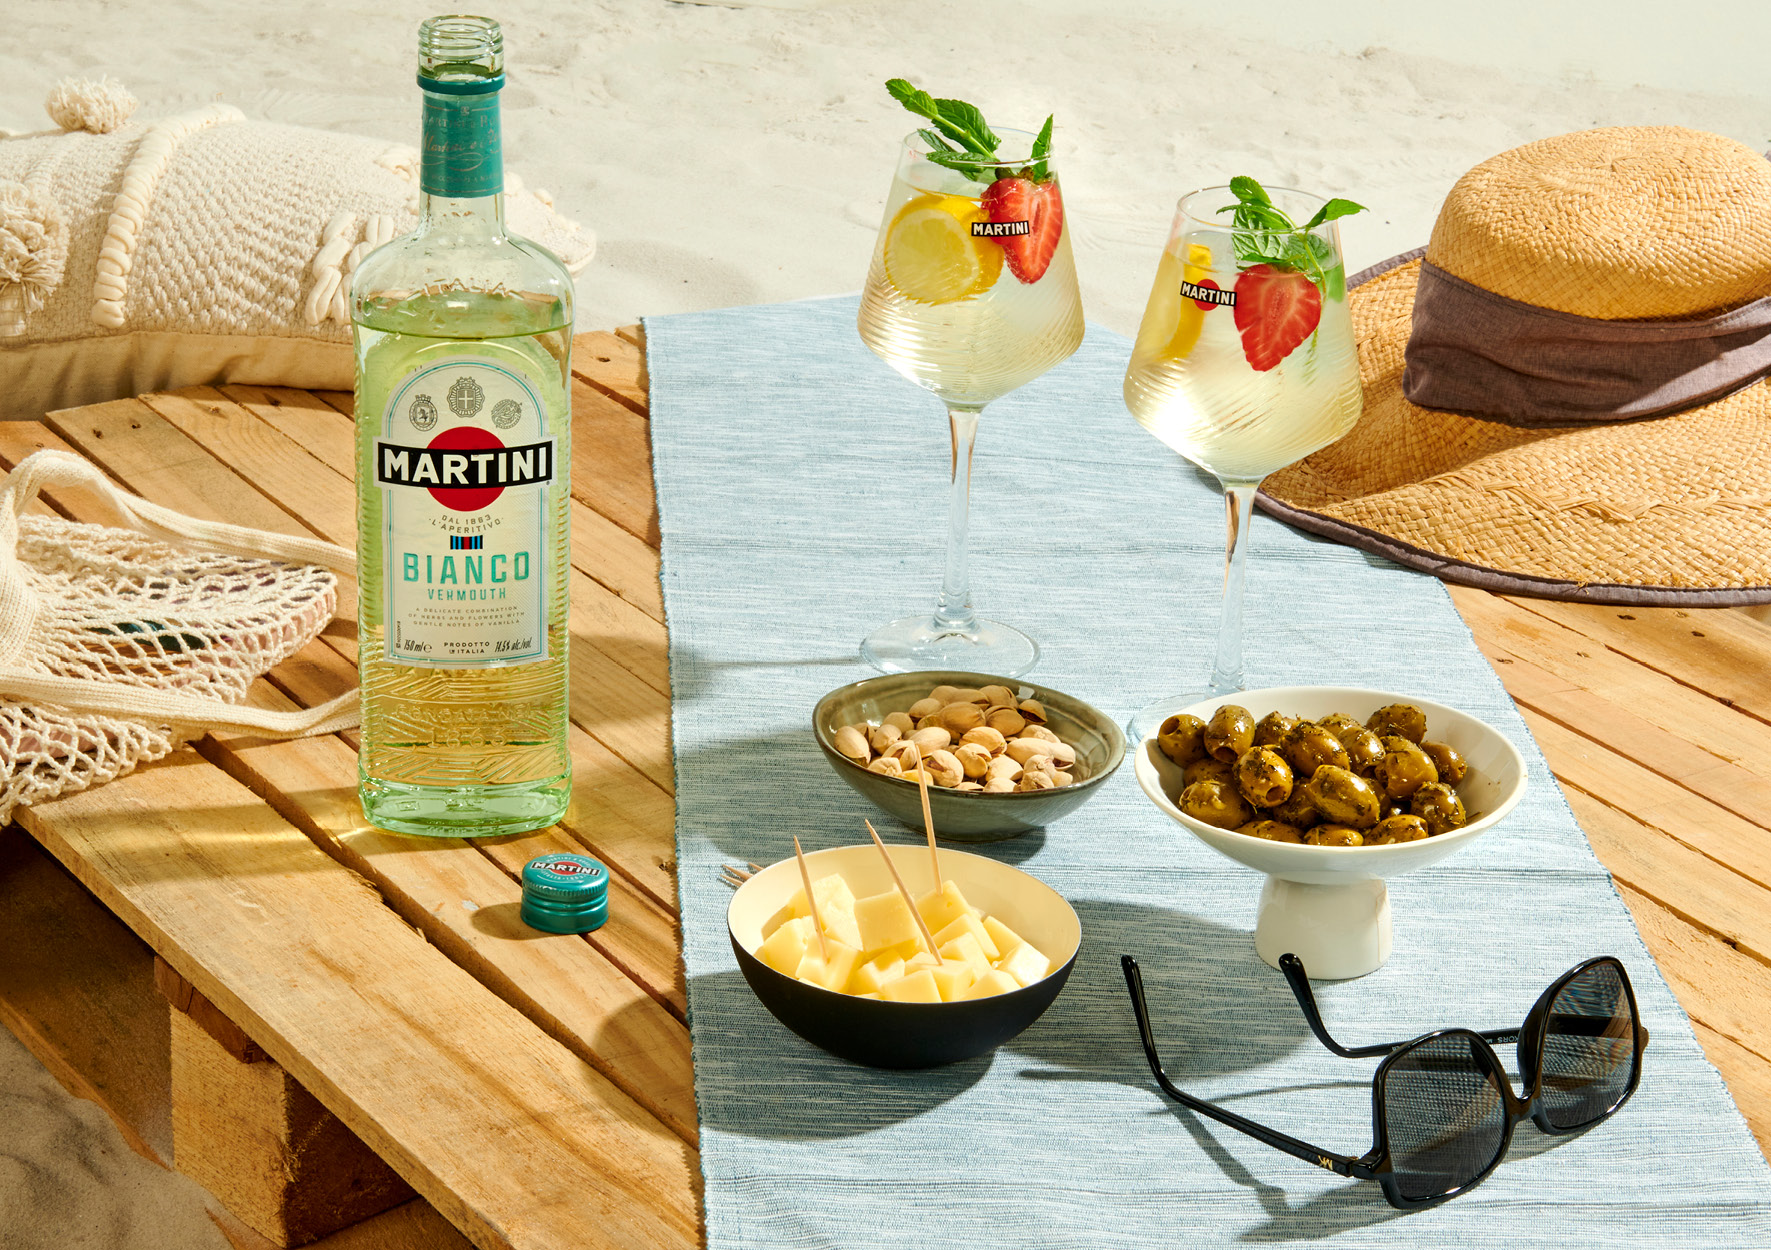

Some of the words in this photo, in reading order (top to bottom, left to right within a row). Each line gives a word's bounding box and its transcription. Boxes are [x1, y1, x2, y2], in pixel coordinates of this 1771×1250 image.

[973, 221, 1029, 236] MARTINI
[1181, 282, 1236, 306] MARTINI
[384, 446, 547, 485] MARTINI
[441, 514, 460, 525] DAL
[465, 514, 491, 525] 1863
[403, 551, 530, 585] BIANCO
[427, 587, 506, 601] VERMOUTH
[465, 605, 518, 614] COMBINATION
[488, 619, 520, 627] VANILLA
[443, 641, 490, 649] PRODOTTO
[534, 862, 598, 875] MARTINI
